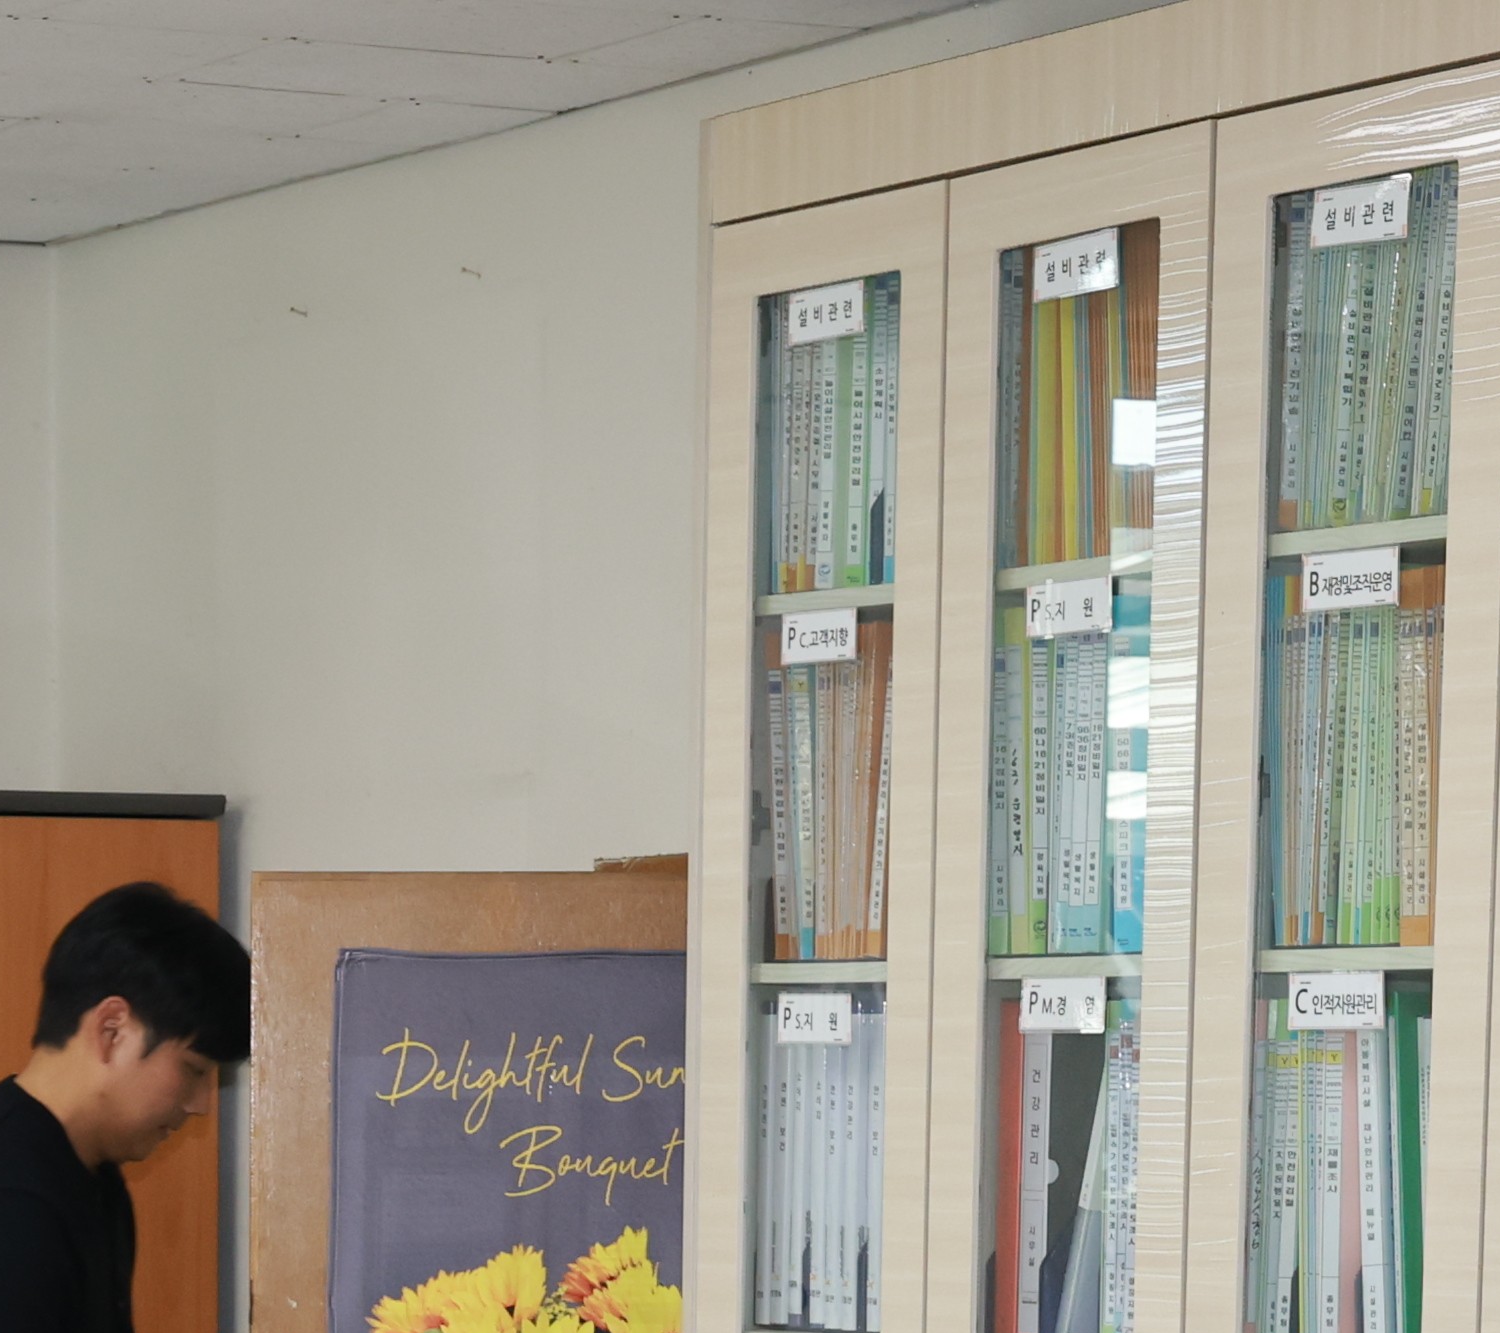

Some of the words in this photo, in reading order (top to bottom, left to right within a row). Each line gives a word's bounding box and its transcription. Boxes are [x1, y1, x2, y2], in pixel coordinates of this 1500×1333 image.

[1309, 570, 1319, 597] B
[1321, 570, 1393, 597] 재정및조직운영
[1031, 599, 1041, 622] P
[788, 627, 796, 650] P
[1029, 991, 1038, 1015] P
[1295, 988, 1308, 1014] C
[1311, 992, 1377, 1016] 인적자원관리
[783, 1007, 792, 1029] P
[375, 1028, 593, 1134] Delightful
[1029, 1068, 1041, 1166] 건강관리
[500, 1125, 680, 1206] Bouquet
